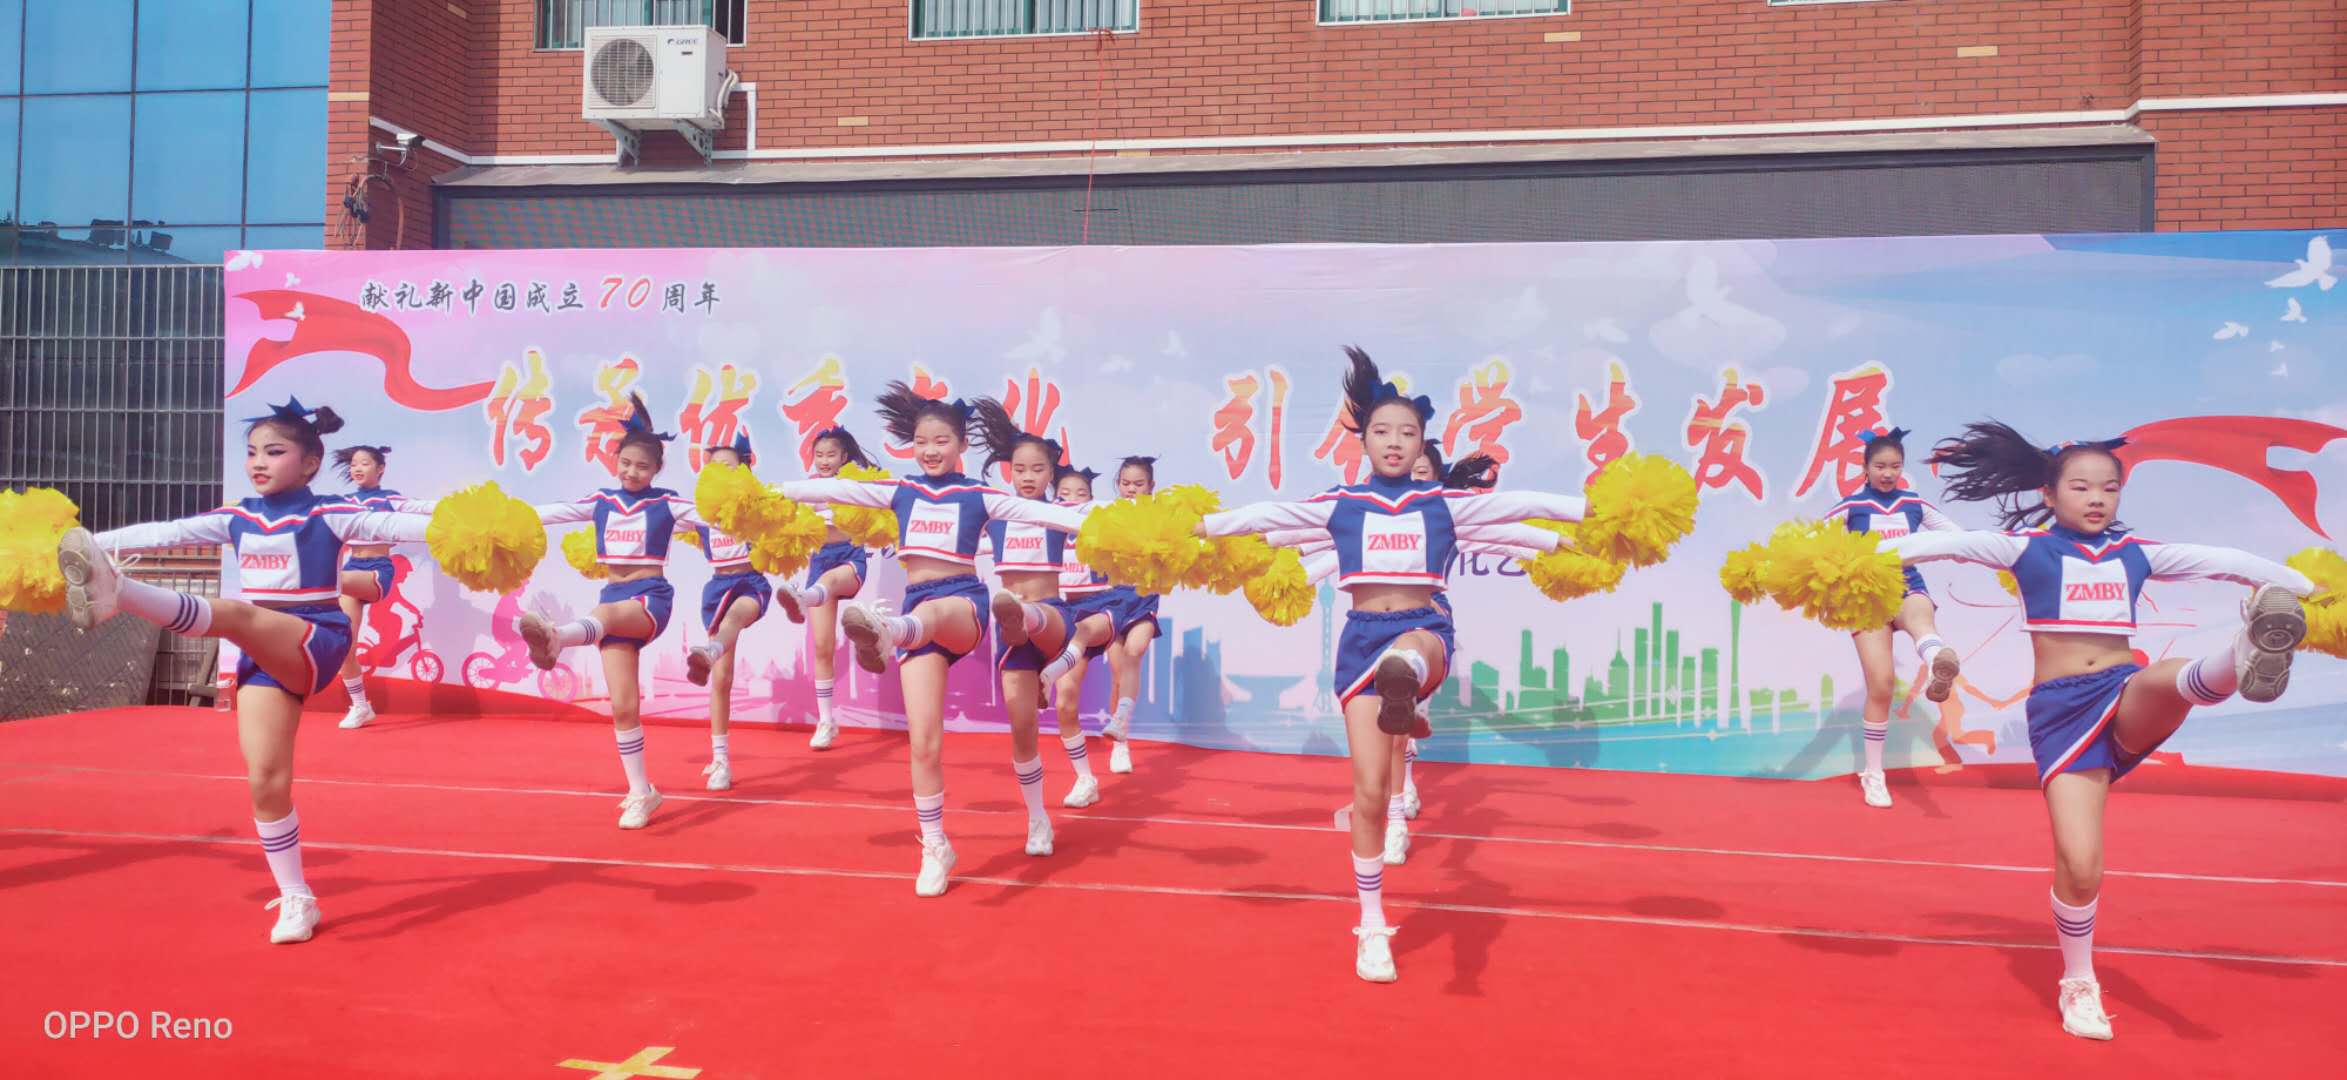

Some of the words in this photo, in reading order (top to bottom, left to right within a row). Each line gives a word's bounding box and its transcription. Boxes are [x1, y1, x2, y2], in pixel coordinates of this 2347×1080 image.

[361, 277, 721, 314] 献礼新中国成立70周年
[909, 519, 954, 535] ZMBY
[605, 529, 645, 544] ZMBY
[1006, 536, 1043, 550] ZMBY
[1367, 533, 1424, 551] ZMBY
[240, 553, 292, 570] ZMBY
[2065, 582, 2126, 602] ZMBY
